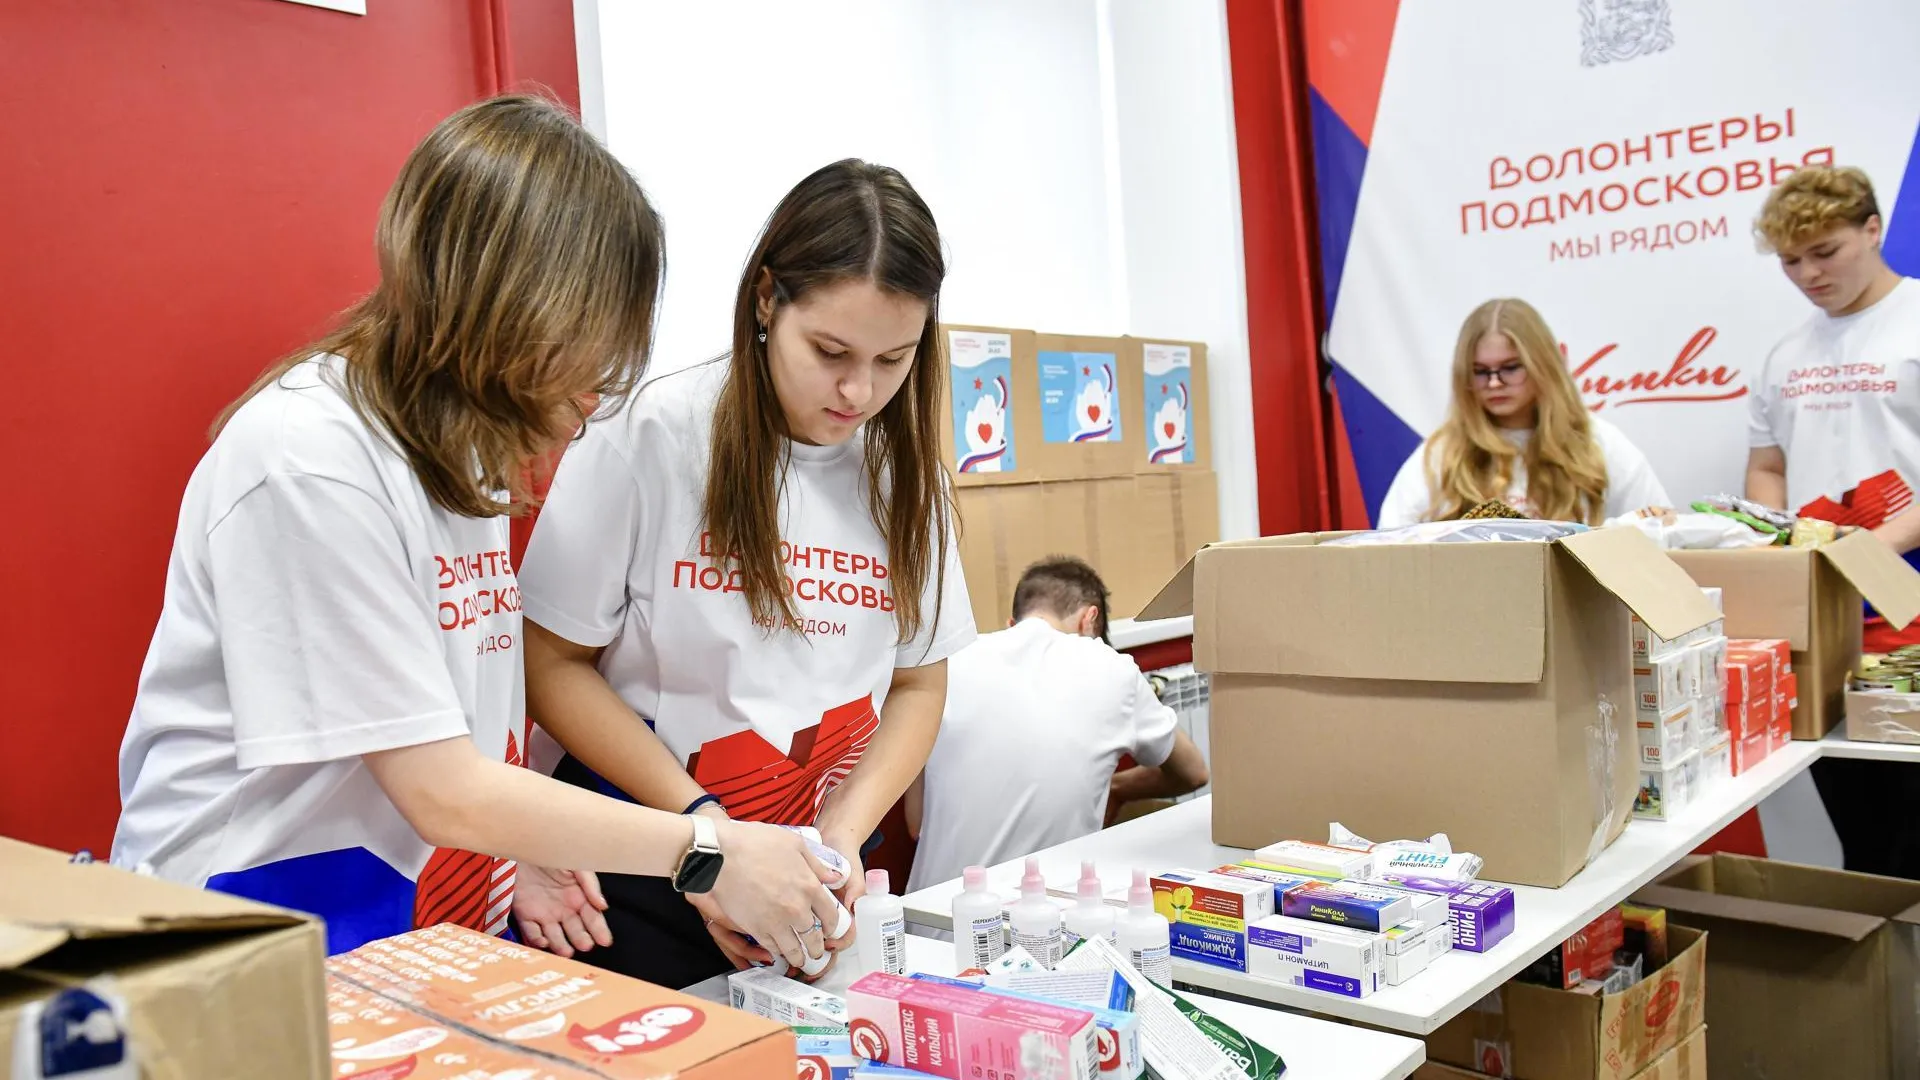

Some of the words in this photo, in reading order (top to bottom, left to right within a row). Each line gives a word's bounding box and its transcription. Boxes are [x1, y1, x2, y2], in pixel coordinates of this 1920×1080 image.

[1488, 107, 1796, 191] ВОЛОНТЕРЫ
[1460, 146, 1835, 235] ПОДМОСКОВЬЯ
[1549, 234, 1601, 262] МЫ
[1610, 215, 1729, 253] РЯДОМ
[1459, 910, 1477, 947] РИНО
[1285, 954, 1329, 970] ЦИТРАМОН
[901, 1008, 919, 1065] КОМПЛЕКС
[924, 1017, 943, 1067] КАЛЬЦИЙ
